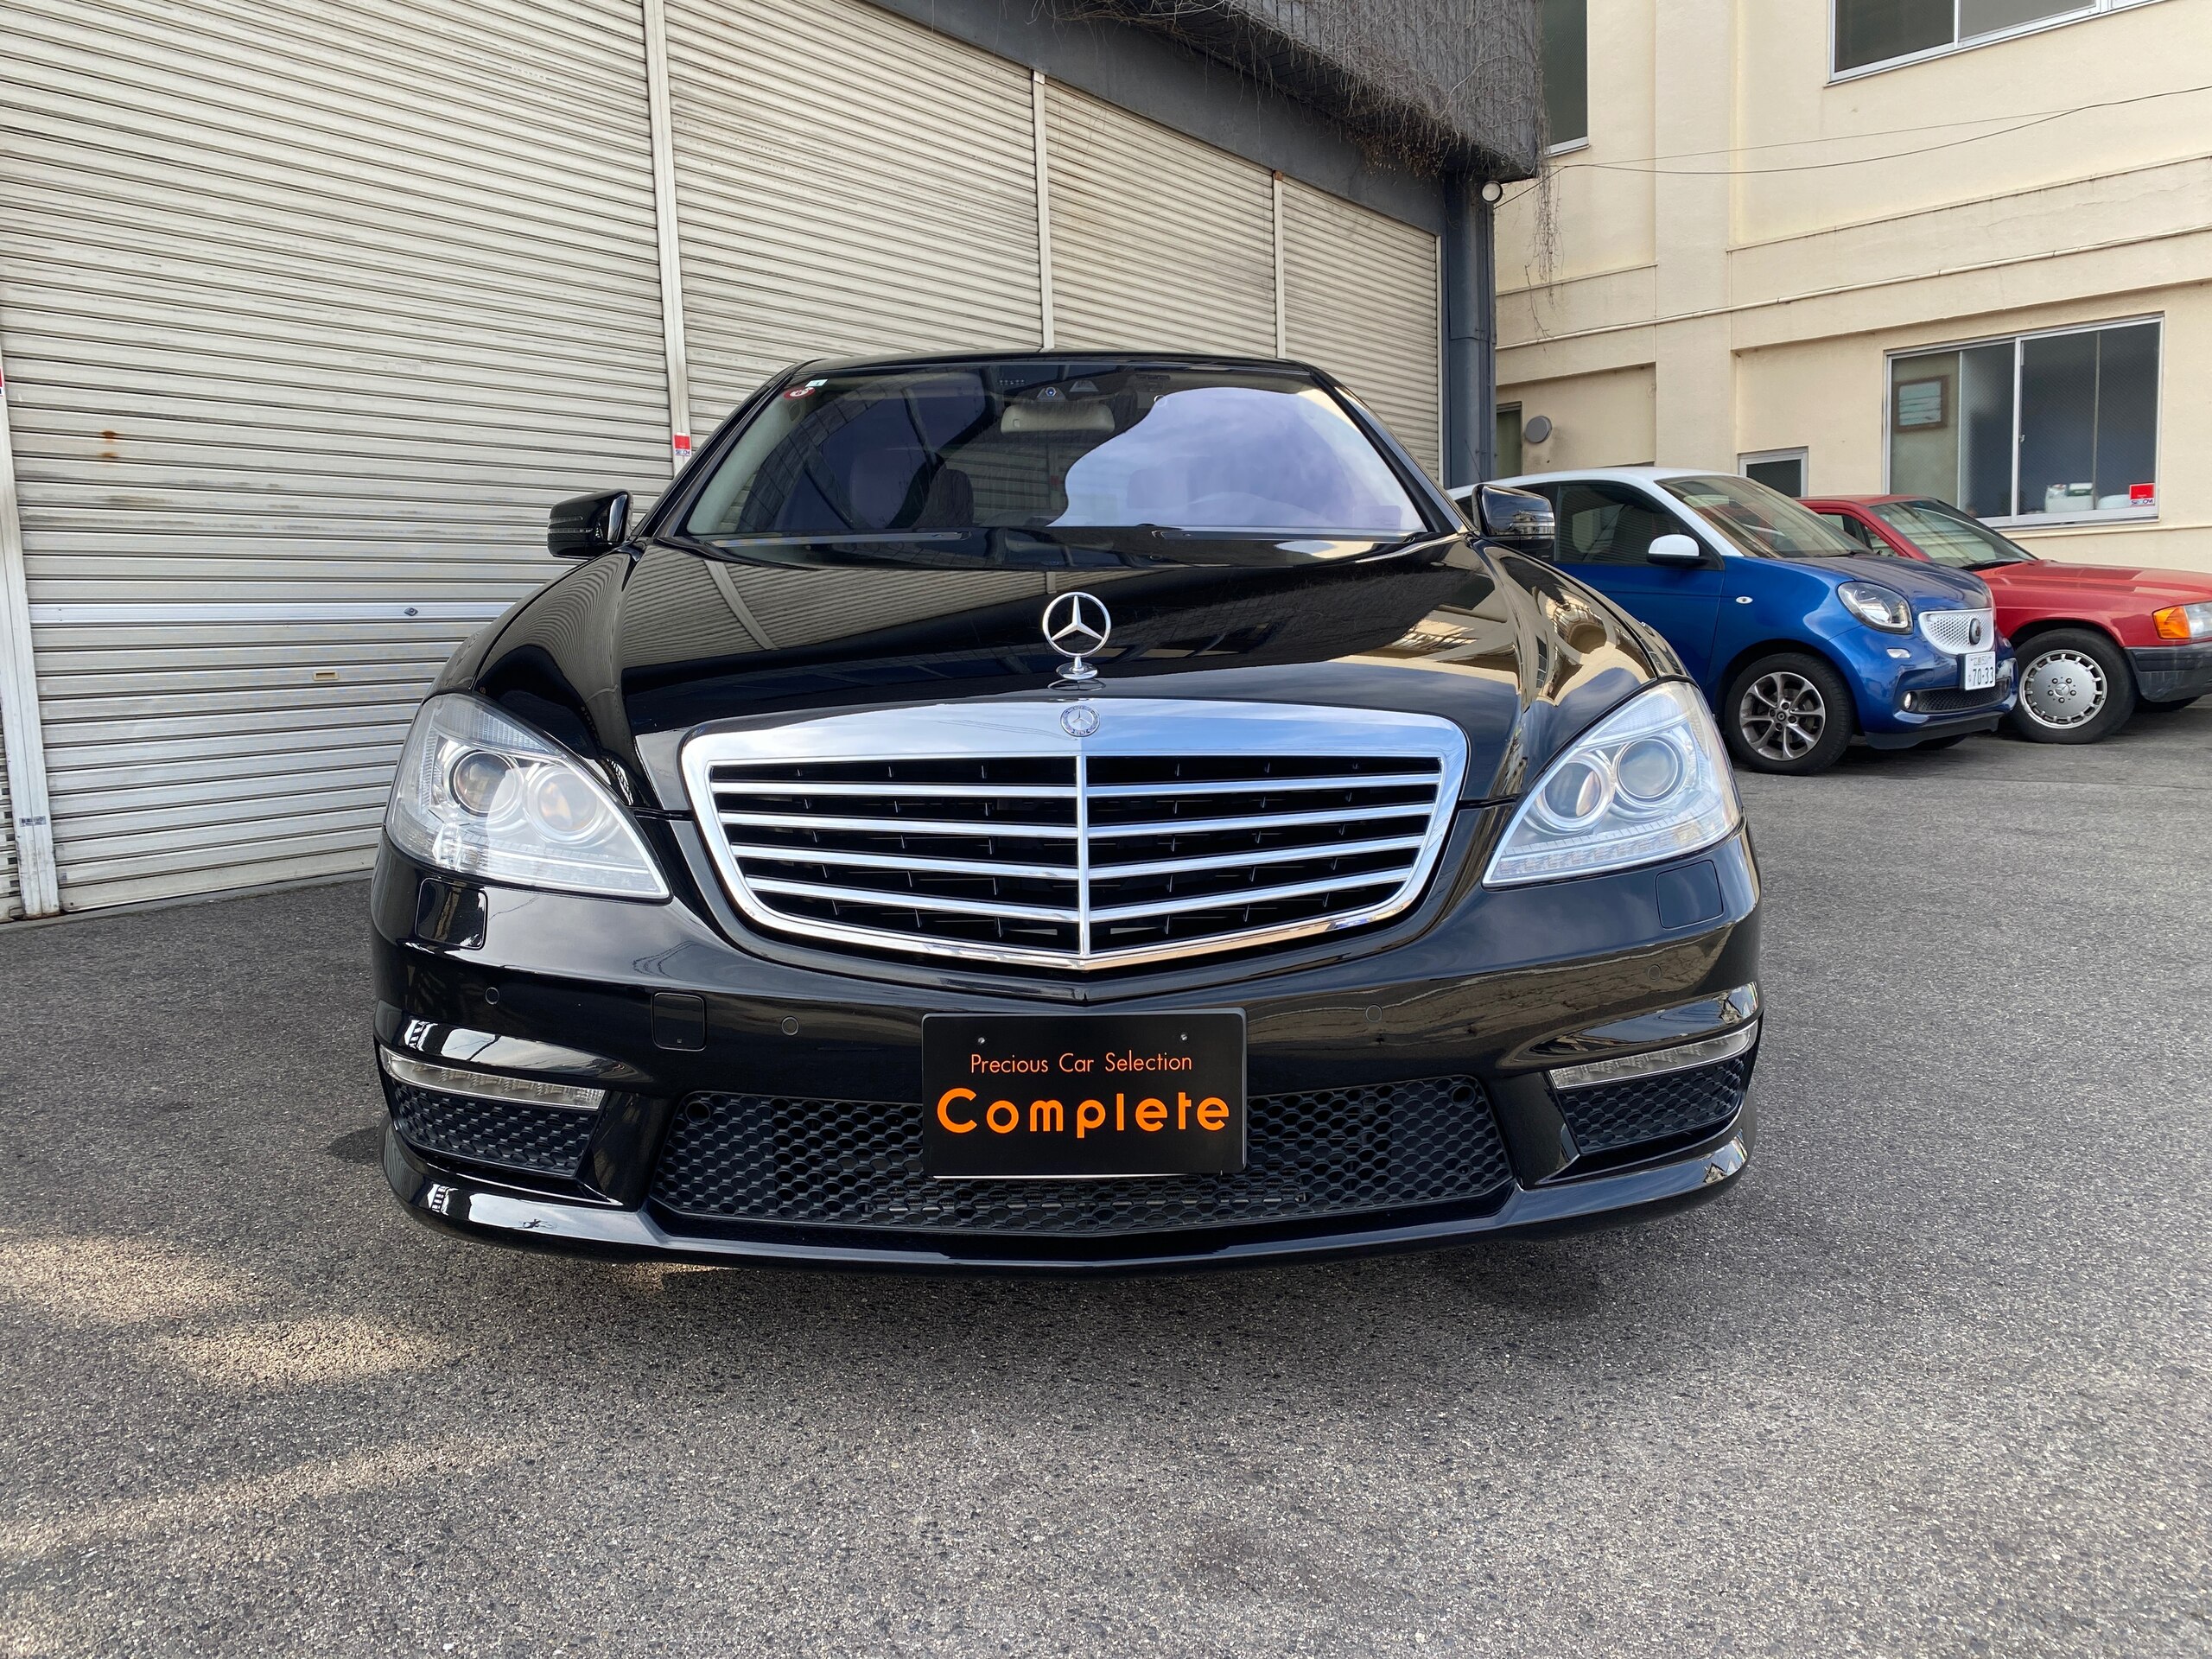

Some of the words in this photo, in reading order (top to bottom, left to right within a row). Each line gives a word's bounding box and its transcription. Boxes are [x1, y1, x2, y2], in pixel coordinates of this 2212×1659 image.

[970, 1054, 1048, 1073] Precious
[1058, 1052, 1094, 1072] Car
[1105, 1050, 1192, 1071] Selection
[937, 1087, 1230, 1139] Complete
